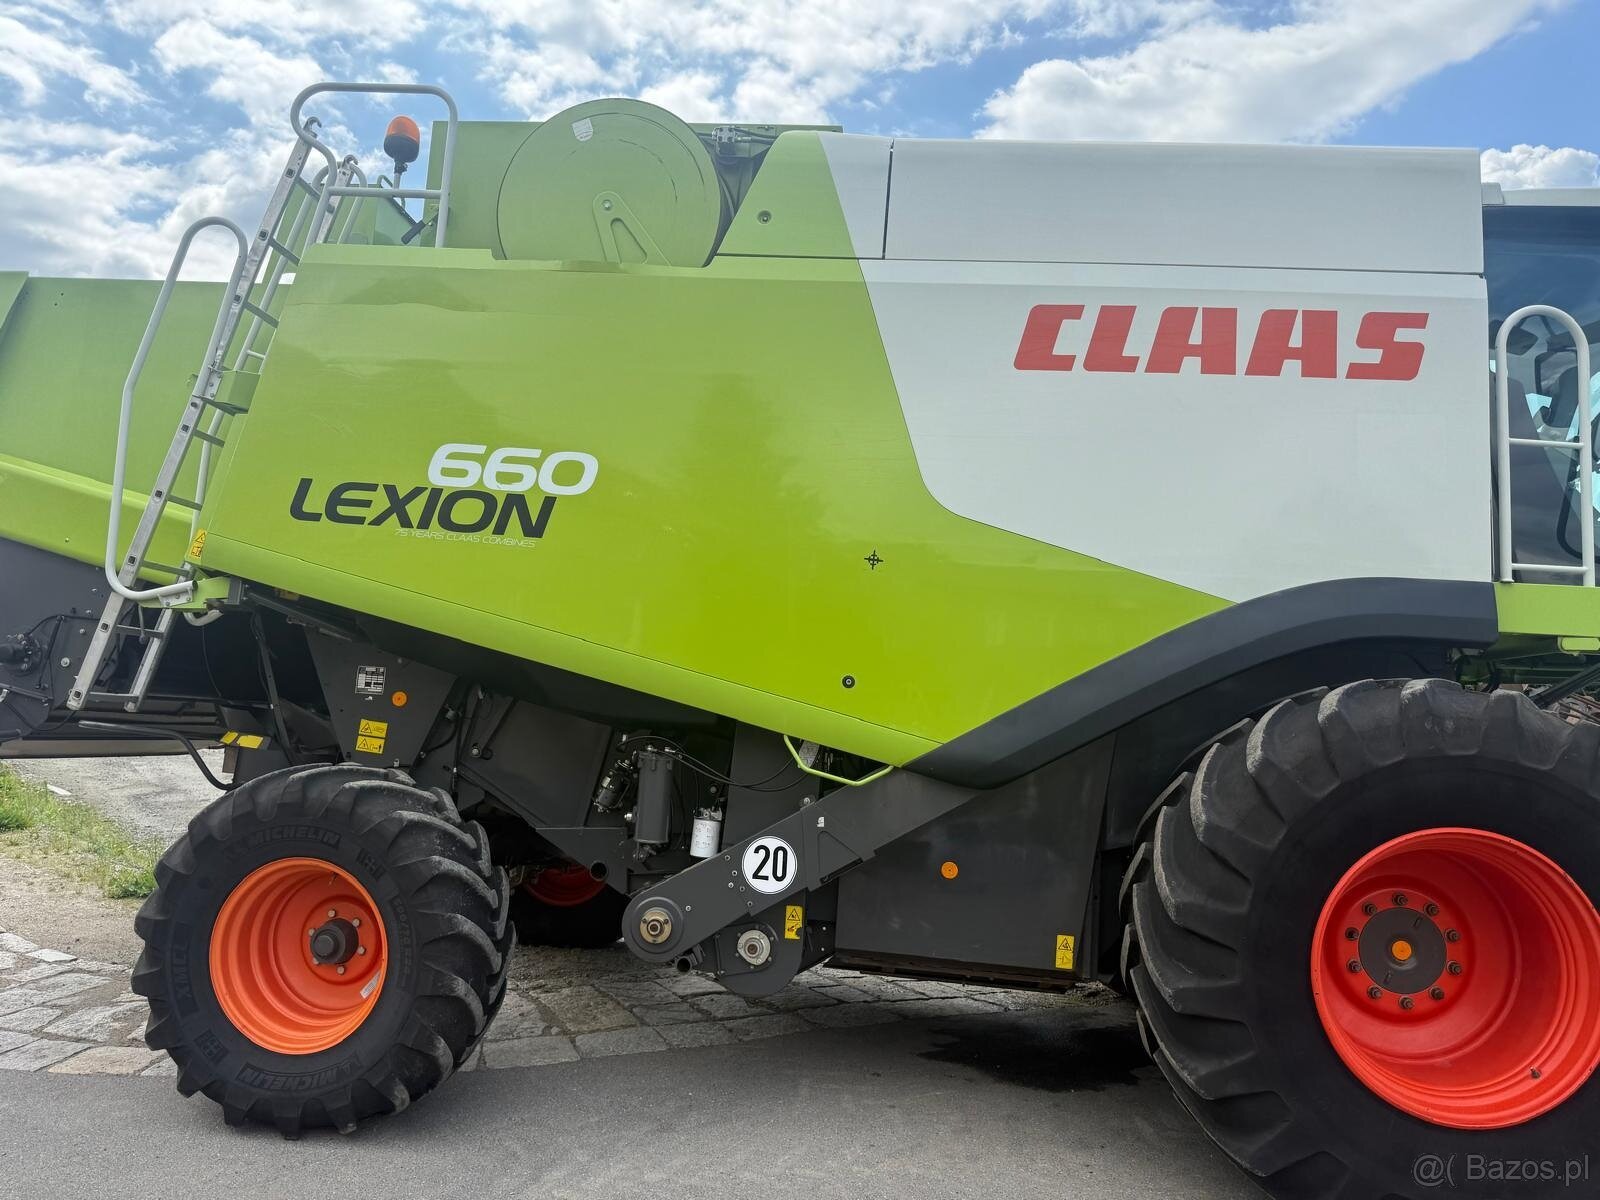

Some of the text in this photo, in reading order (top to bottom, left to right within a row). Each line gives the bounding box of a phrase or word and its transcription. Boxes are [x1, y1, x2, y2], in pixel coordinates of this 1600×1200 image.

[1013, 304, 1430, 381] CLAAS
[427, 443, 599, 495] 660
[289, 477, 557, 539] LEXION
[395, 528, 536, 548] 75 YEARS CLAAS COMBINES
[752, 844, 788, 882] 20
[239, 1068, 337, 1091] MICHELIN
